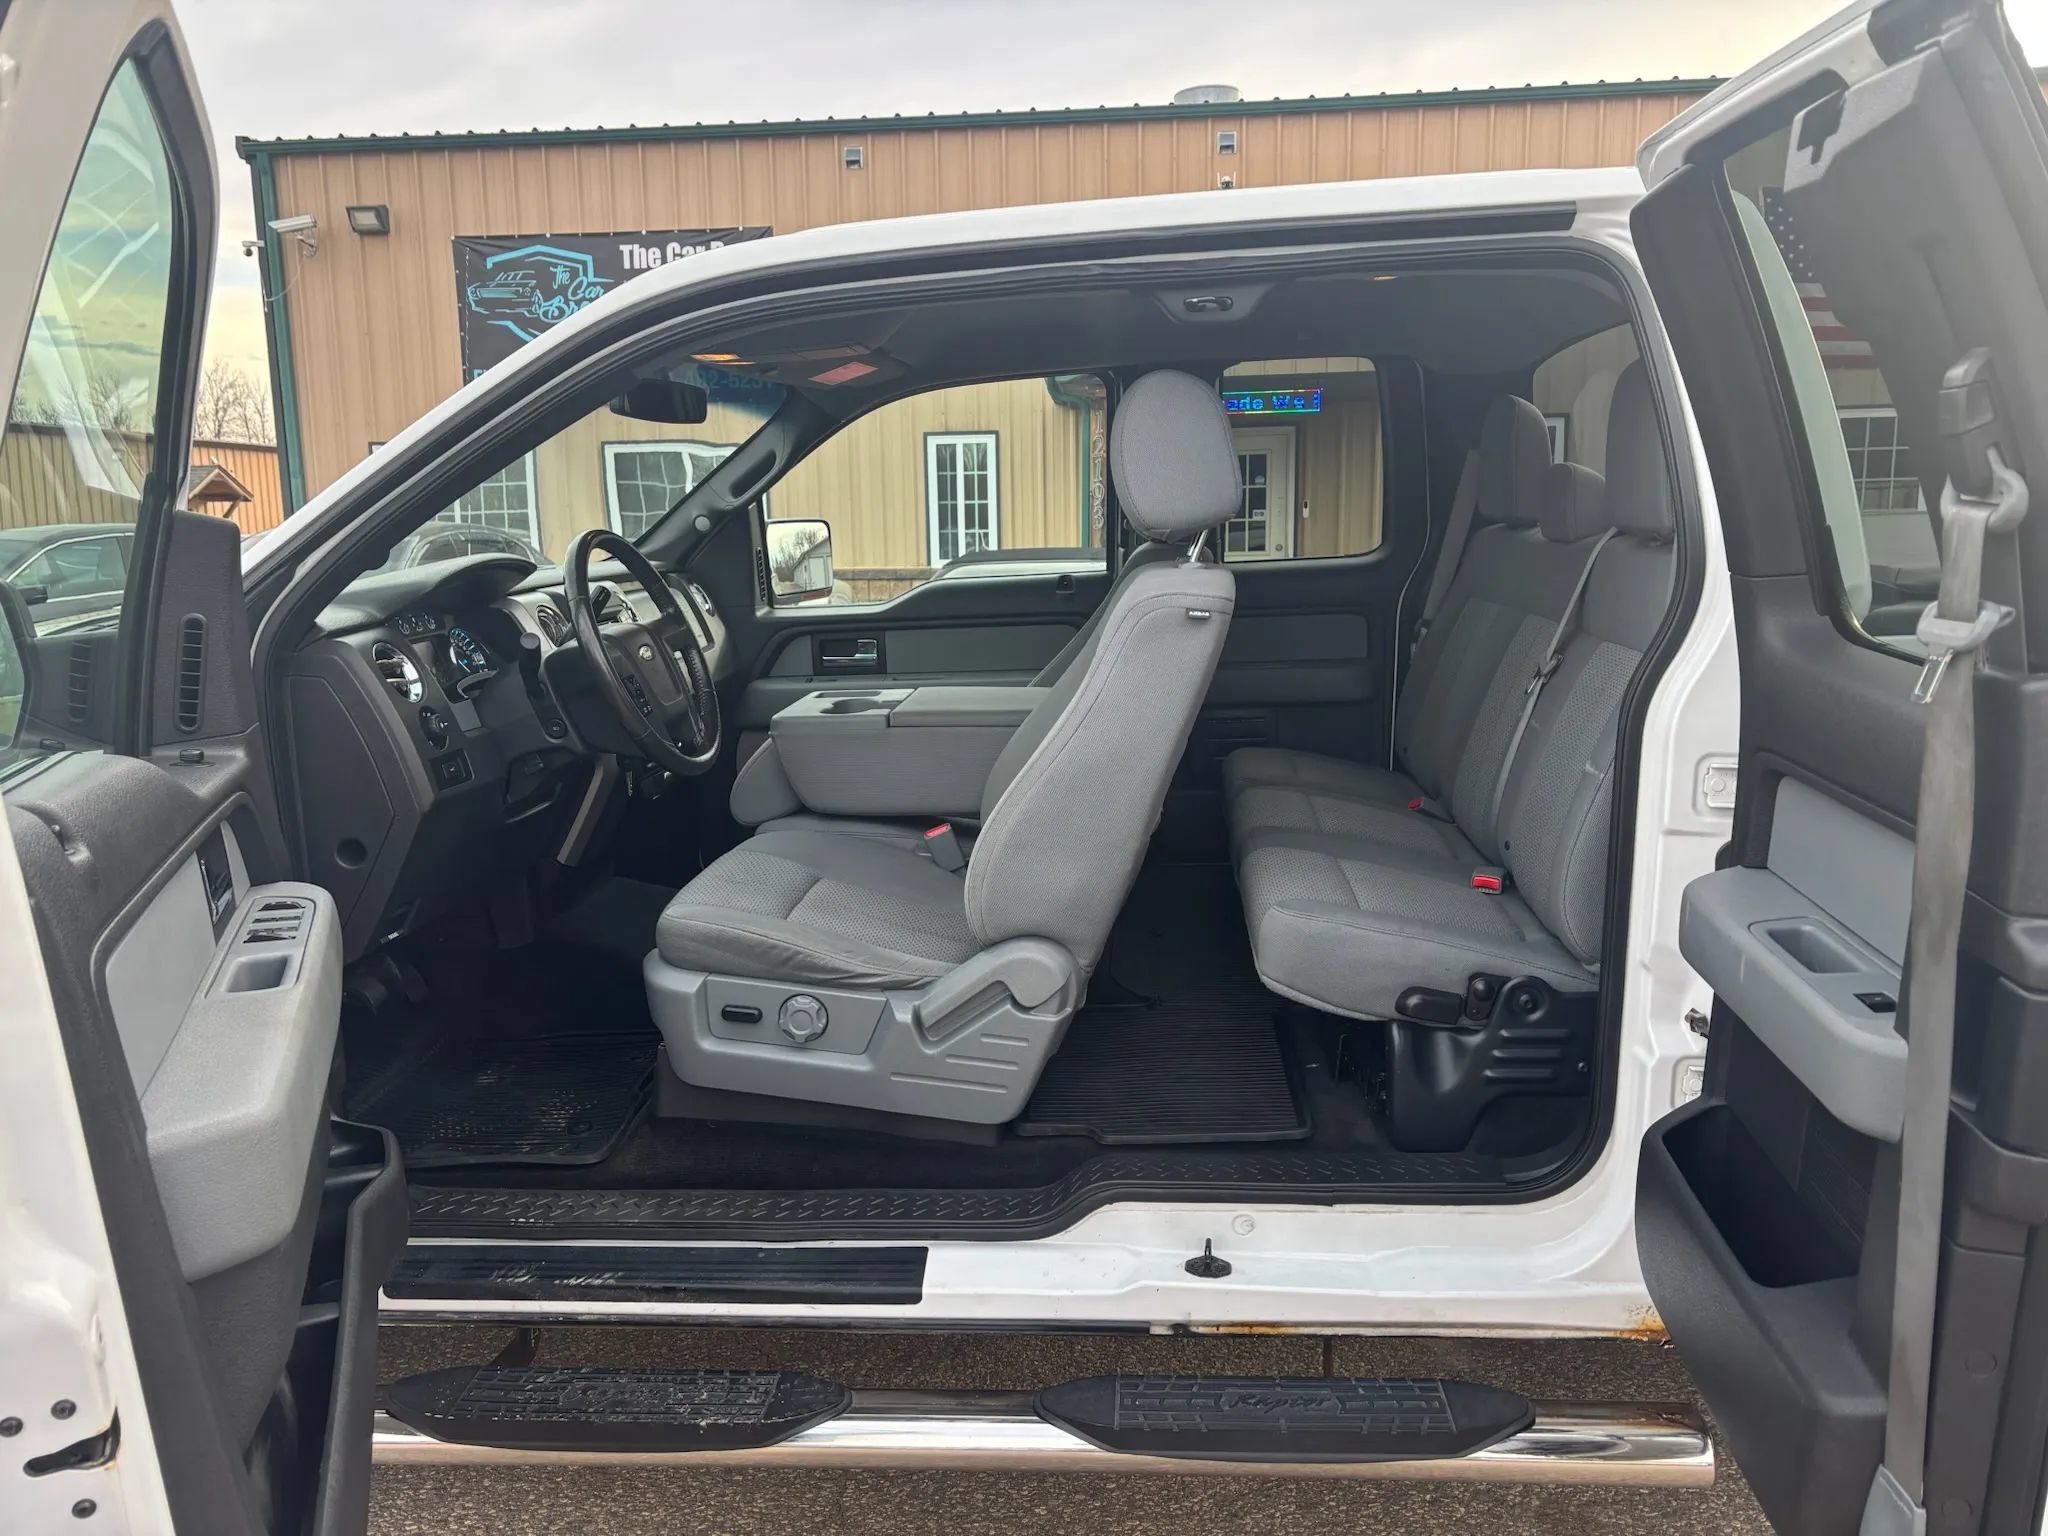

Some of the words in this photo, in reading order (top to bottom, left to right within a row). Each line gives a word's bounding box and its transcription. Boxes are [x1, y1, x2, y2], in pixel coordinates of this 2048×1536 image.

[619, 243, 661, 269] The
[550, 264, 571, 290] The
[568, 276, 605, 300] Car
